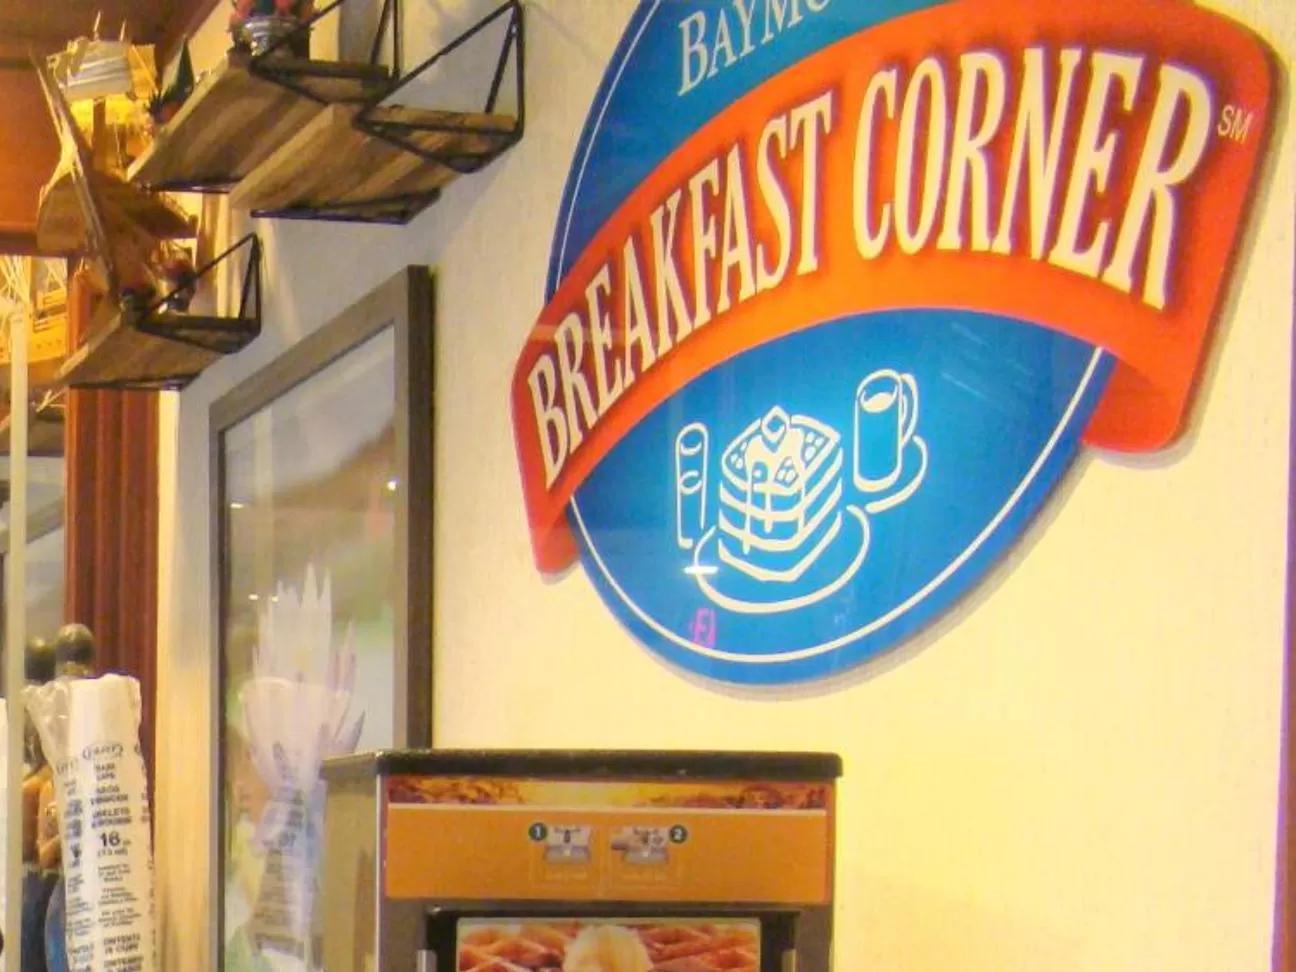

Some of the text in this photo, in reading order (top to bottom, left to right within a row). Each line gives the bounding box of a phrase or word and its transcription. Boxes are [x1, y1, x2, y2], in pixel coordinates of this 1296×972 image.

[527, 46, 1253, 490] BREAKFAST CORNER SM
